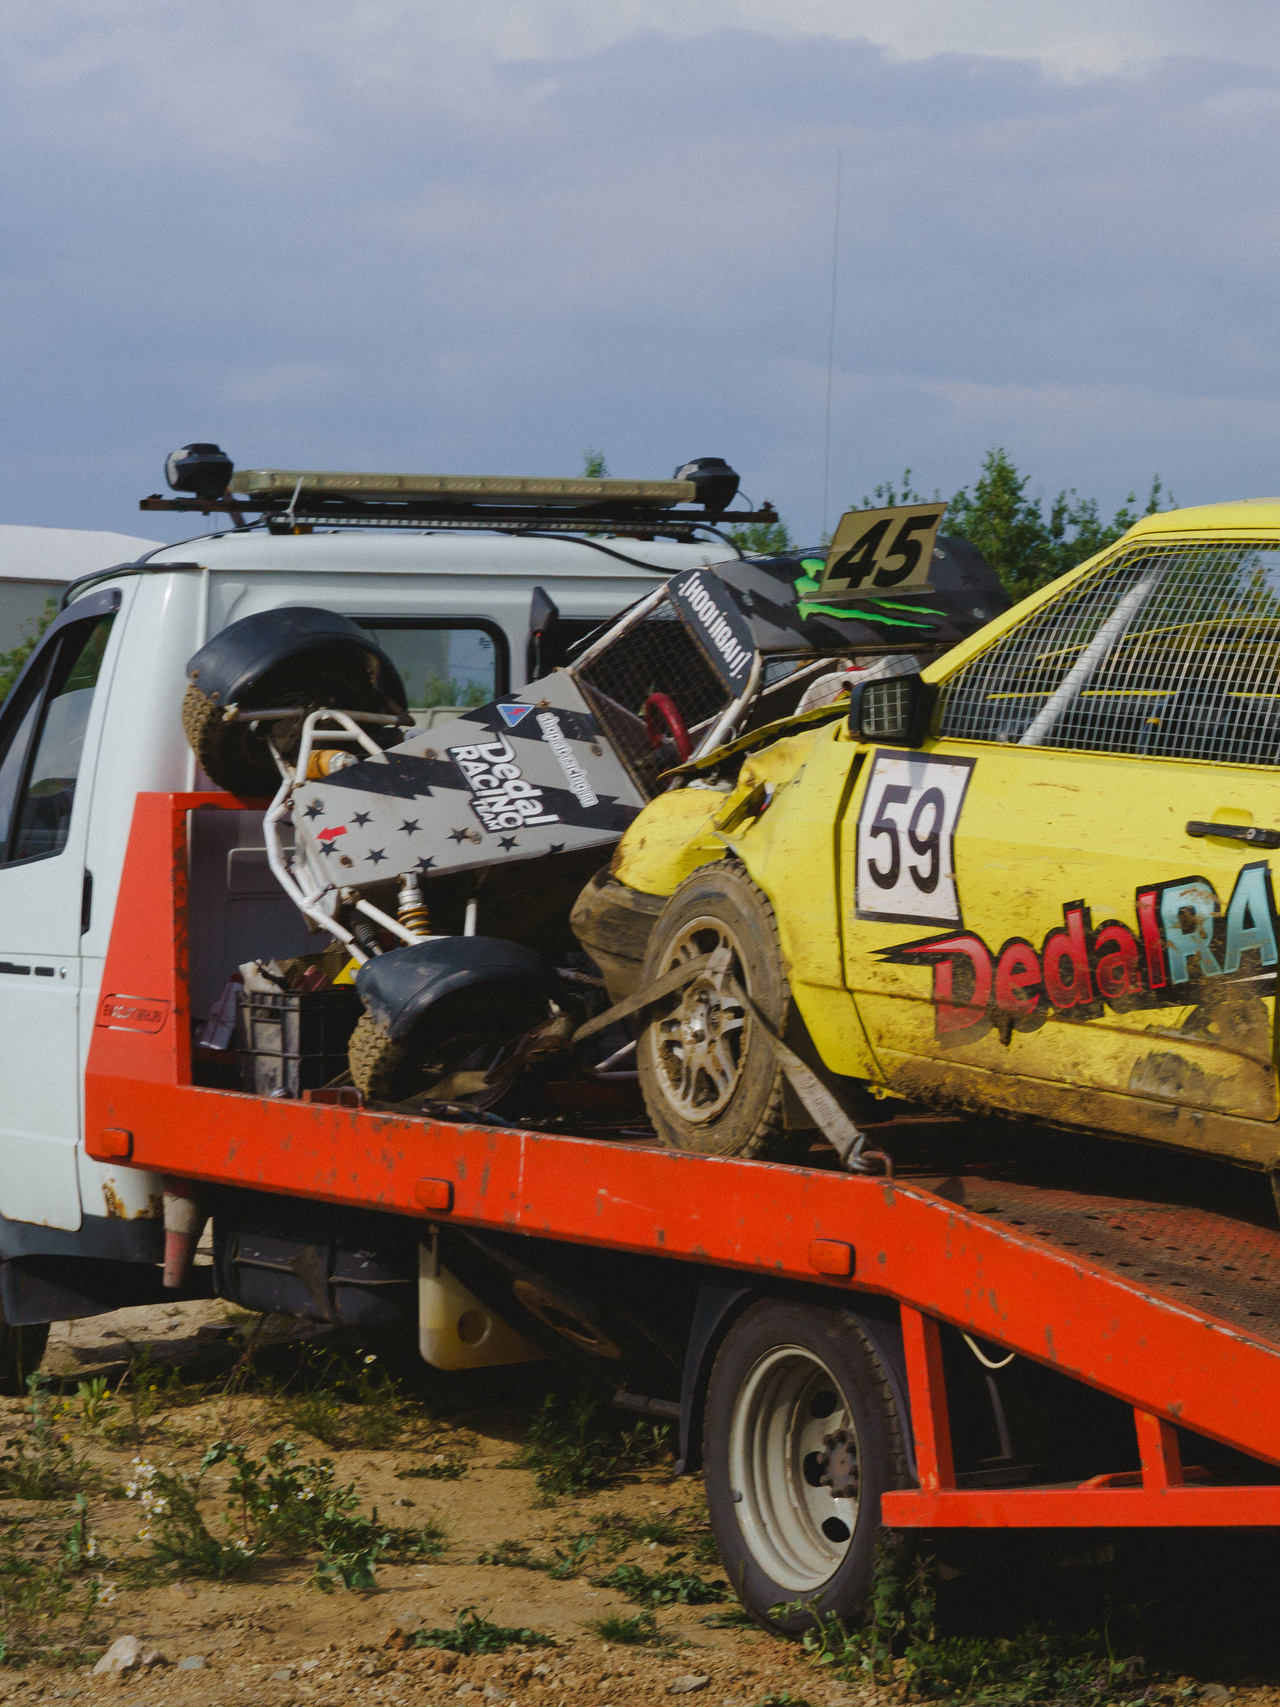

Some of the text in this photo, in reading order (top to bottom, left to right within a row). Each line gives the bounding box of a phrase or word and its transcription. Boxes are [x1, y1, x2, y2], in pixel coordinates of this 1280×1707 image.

[828, 514, 941, 588] 45
[472, 800, 503, 831] TEAM
[475, 731, 560, 825] Dedal
[868, 784, 945, 893] 59
